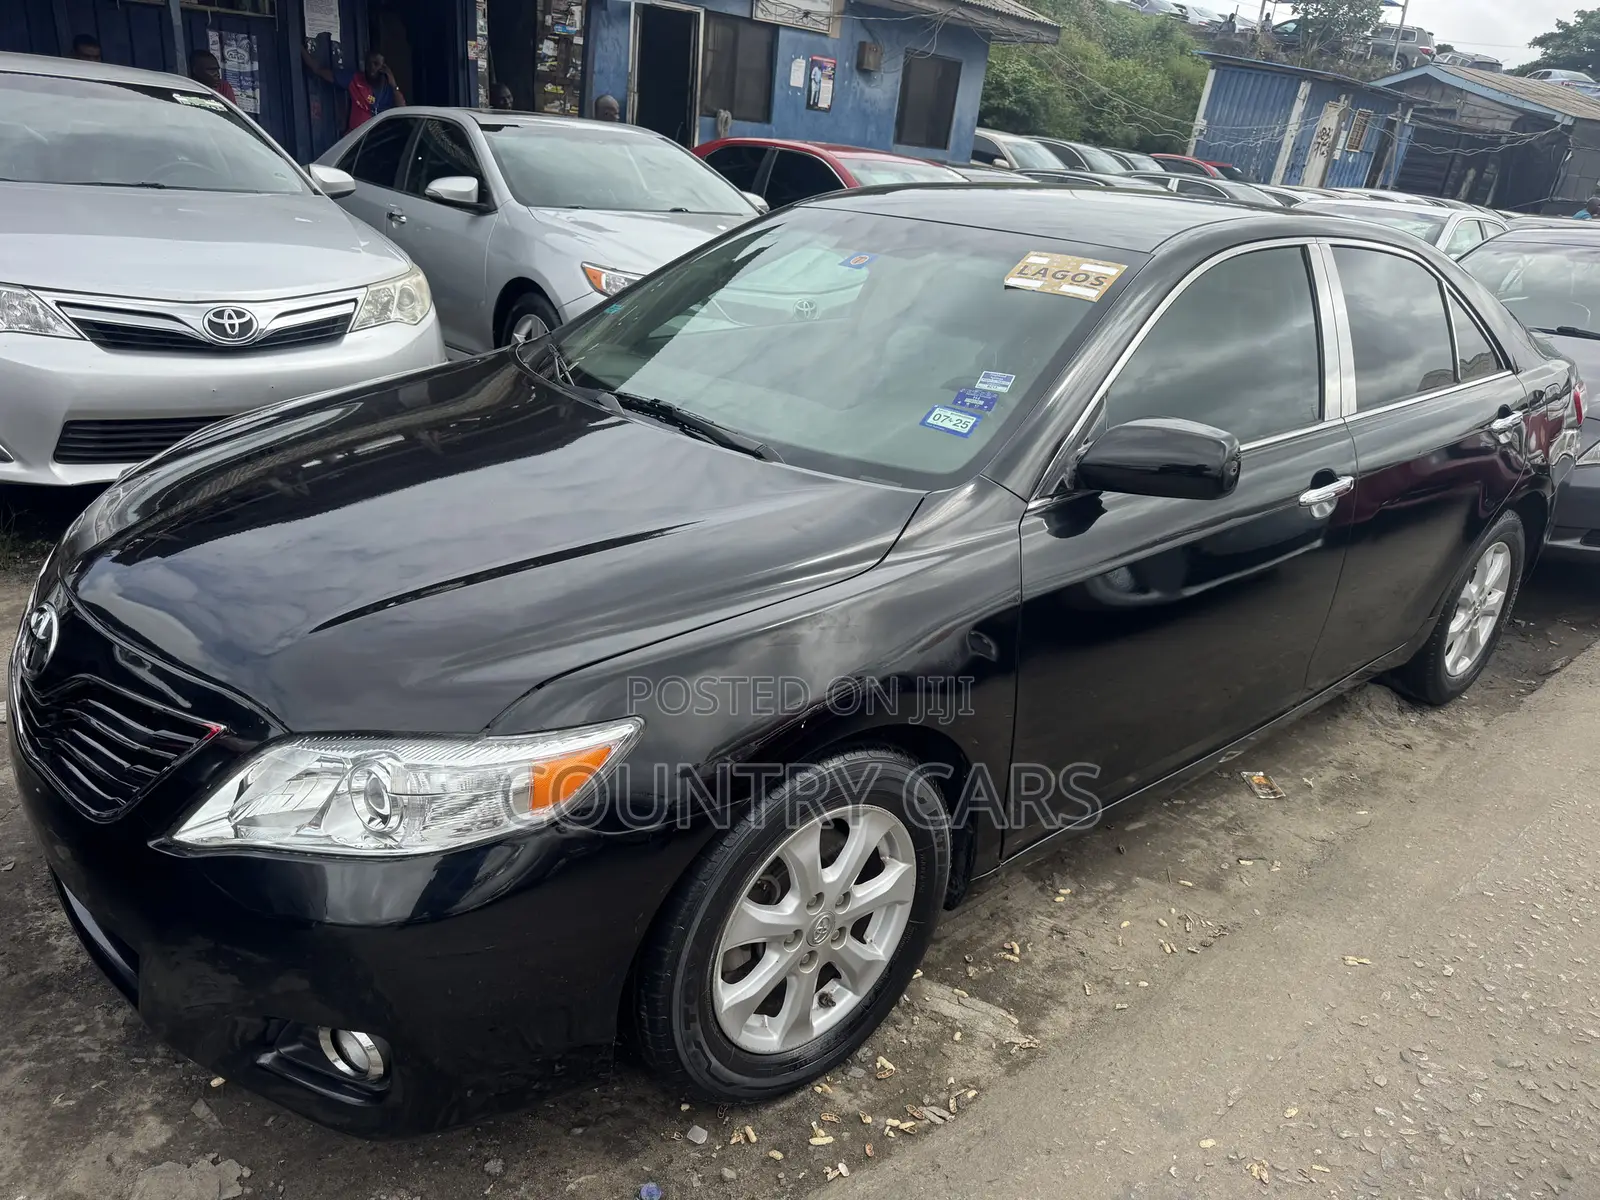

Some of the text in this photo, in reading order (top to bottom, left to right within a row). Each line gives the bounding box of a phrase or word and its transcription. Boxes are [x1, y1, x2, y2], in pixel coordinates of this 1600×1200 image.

[1017, 264, 1108, 287] LAGOS
[932, 413, 951, 424] 07
[952, 418, 971, 430] 25
